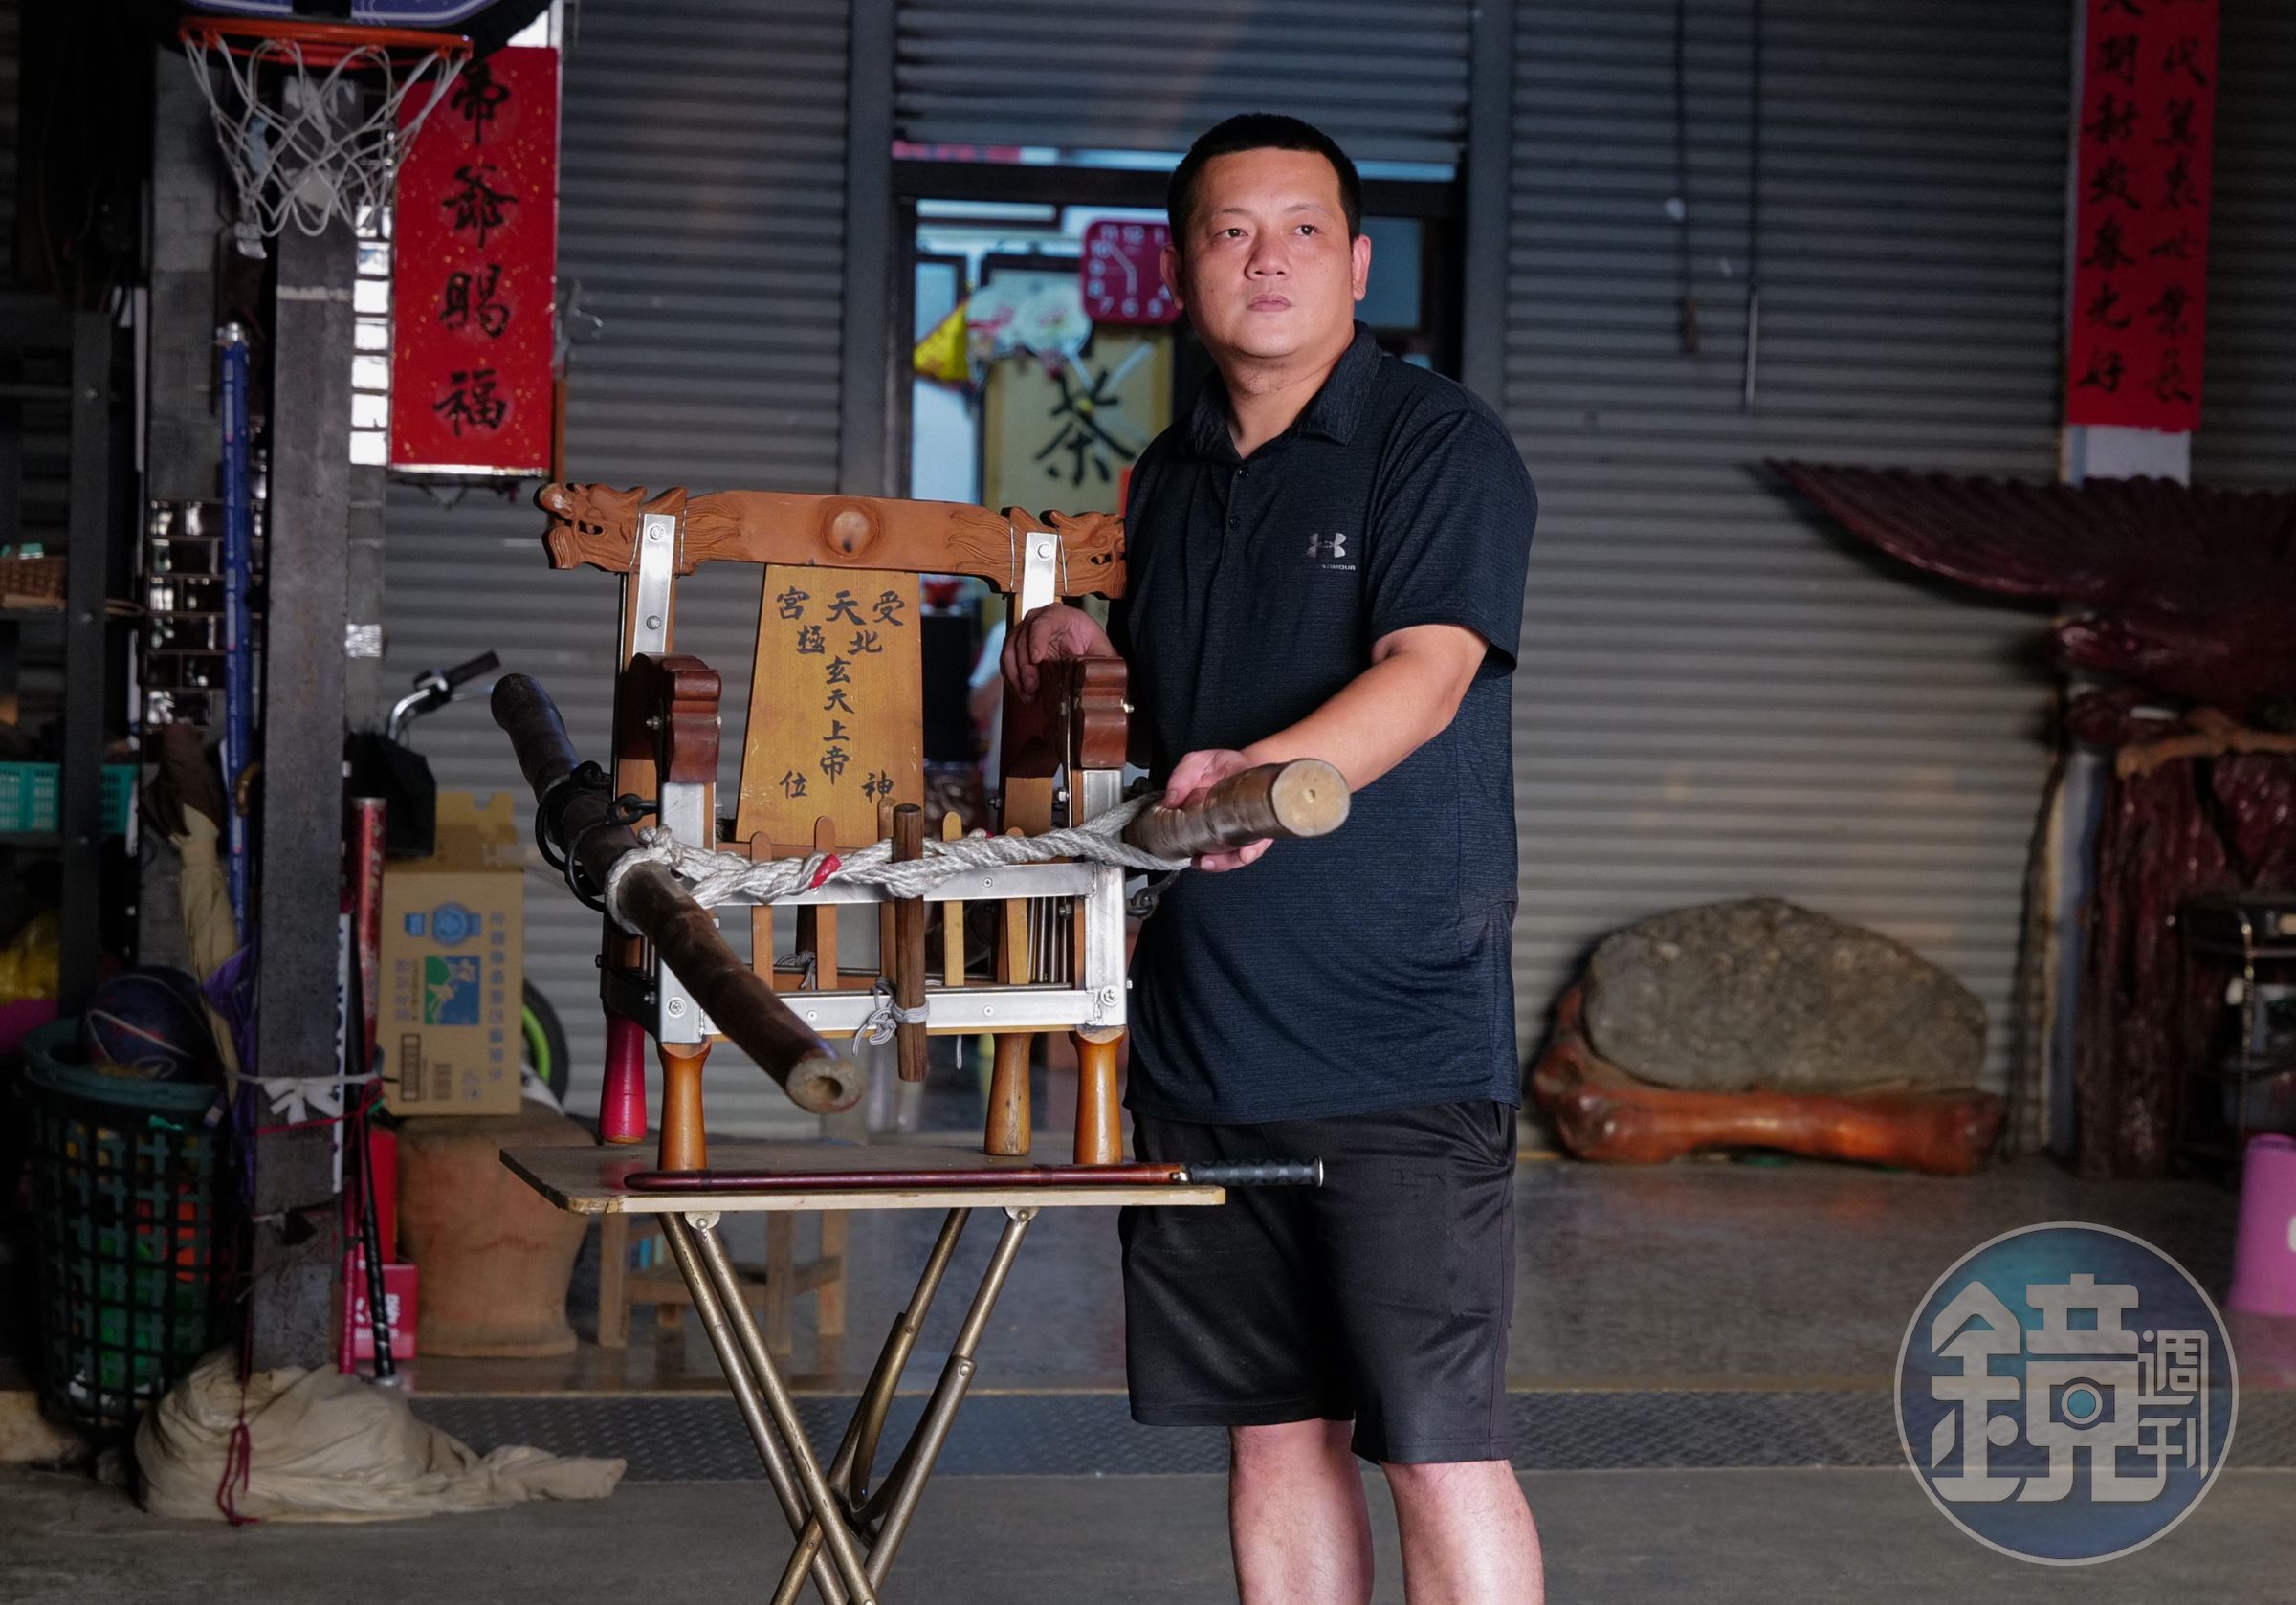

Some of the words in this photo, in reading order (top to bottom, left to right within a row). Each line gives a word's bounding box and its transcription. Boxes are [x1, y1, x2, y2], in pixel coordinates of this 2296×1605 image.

[433, 61, 519, 437] 帝爺賜福
[1034, 370, 1137, 486] 茶
[819, 654, 855, 785] 玄天上帝
